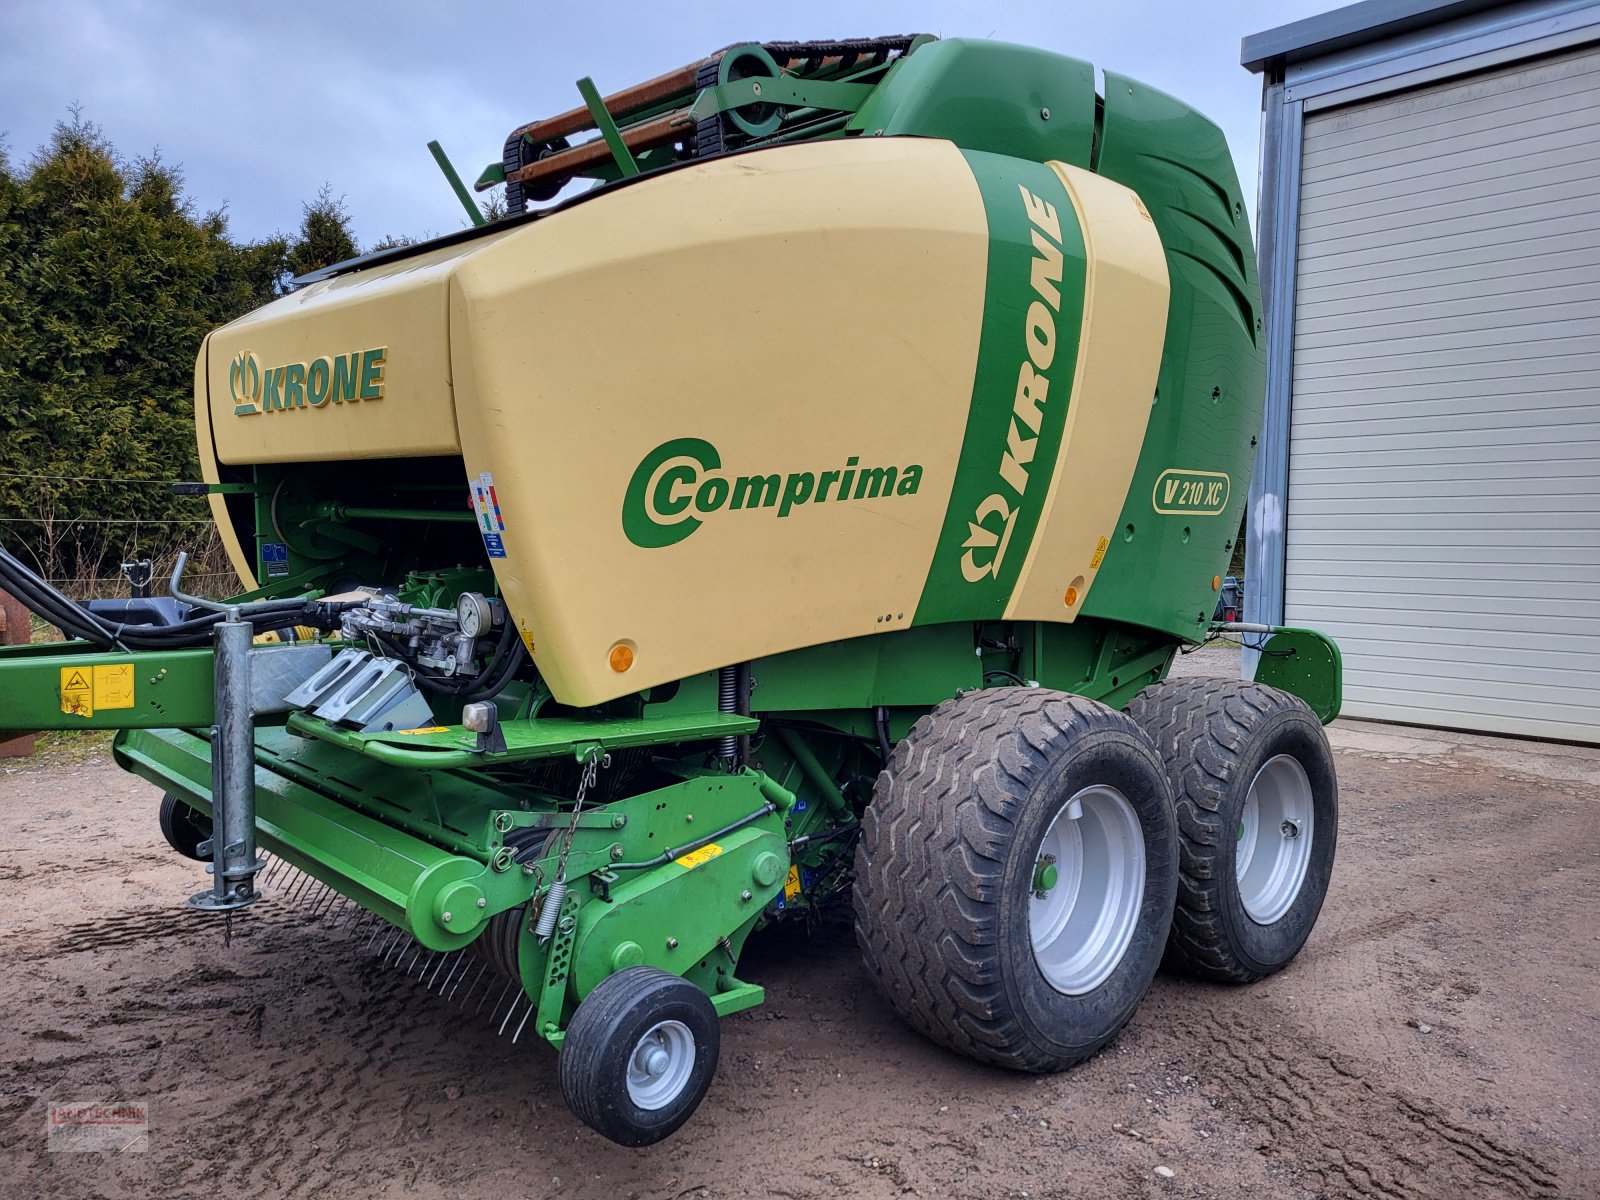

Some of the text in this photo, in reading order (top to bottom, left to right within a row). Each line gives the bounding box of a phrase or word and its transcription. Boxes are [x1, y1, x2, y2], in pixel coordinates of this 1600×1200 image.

[263, 347, 387, 411] KRONE
[1000, 184, 1063, 496] KRONE
[622, 438, 923, 548] Comprima
[1164, 480, 1223, 505] V 210 XC
